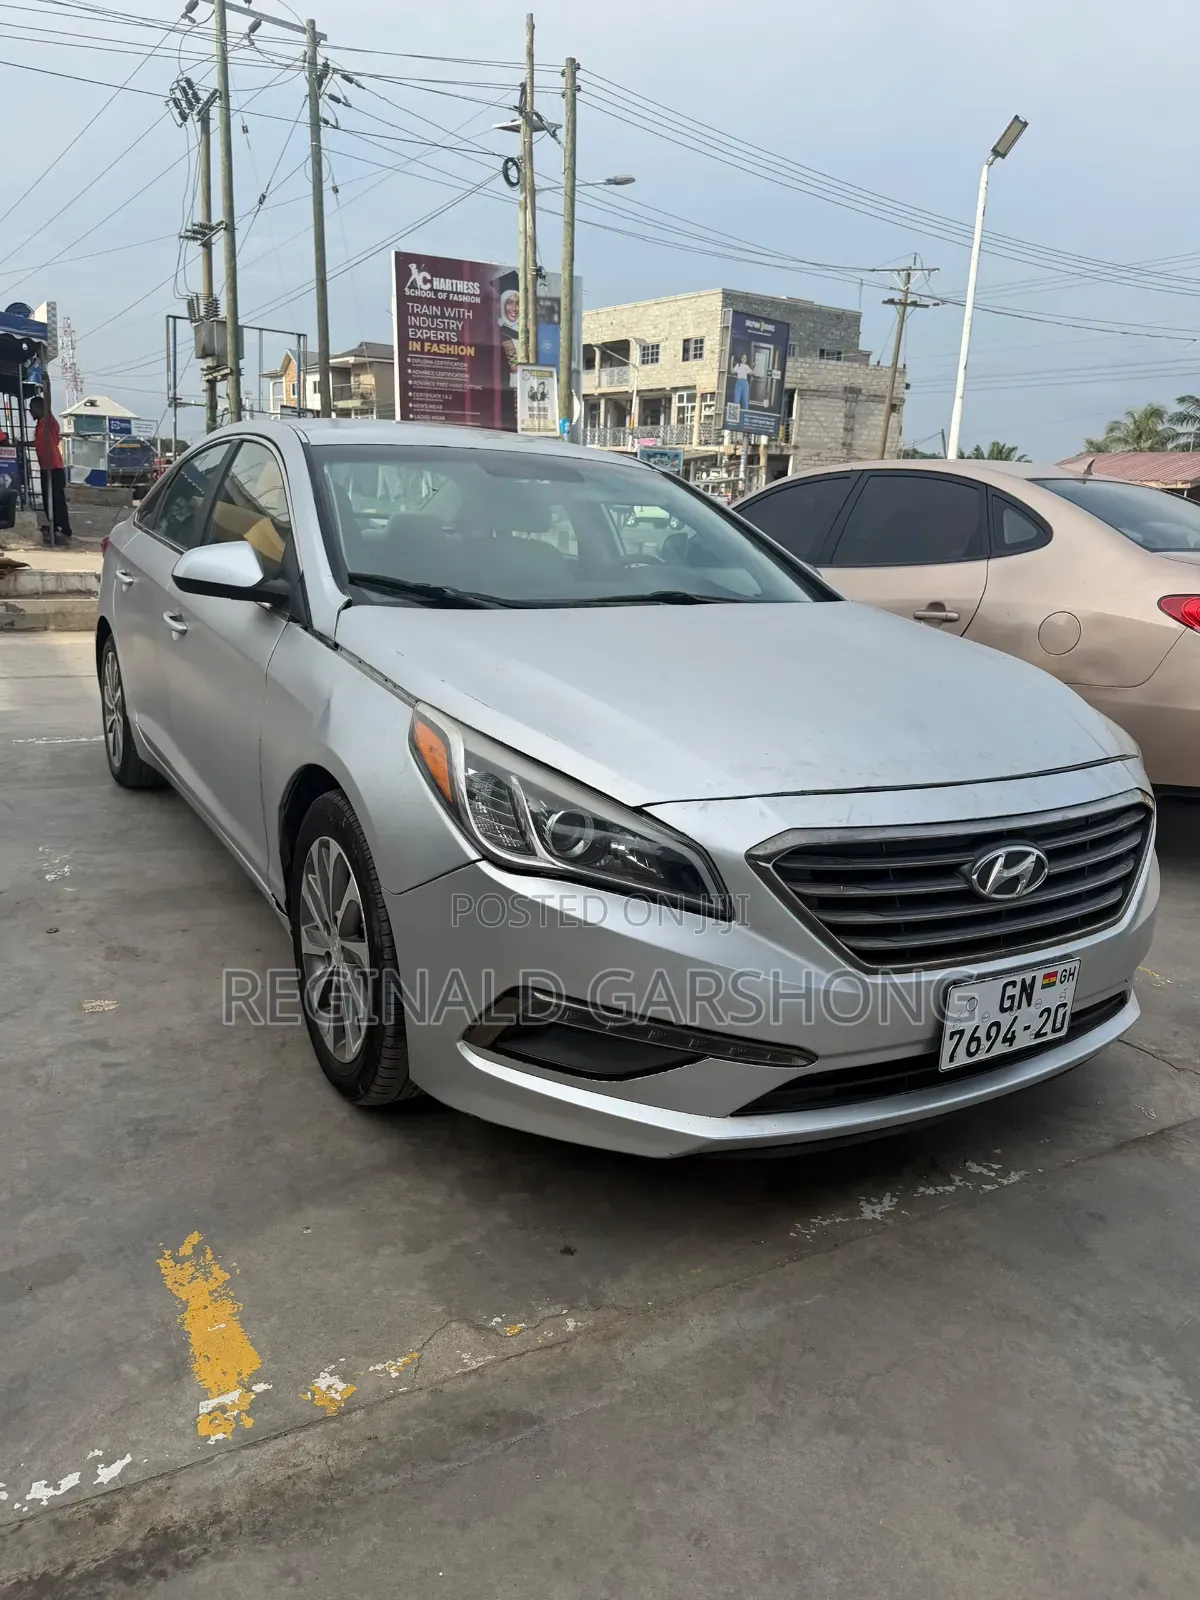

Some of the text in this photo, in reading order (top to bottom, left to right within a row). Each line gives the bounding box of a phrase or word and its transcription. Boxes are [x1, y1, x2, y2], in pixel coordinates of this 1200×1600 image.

[405, 288, 481, 304] SCHOOL OF FASHION
[407, 302, 473, 320] TRAIN WITH
[407, 315, 464, 331] INDUSTRY
[408, 328, 457, 342] EXPERTS
[408, 340, 475, 356] IN FASHION
[999, 966, 1077, 1014] GN GH
[948, 1002, 1068, 1064] 7694-20
